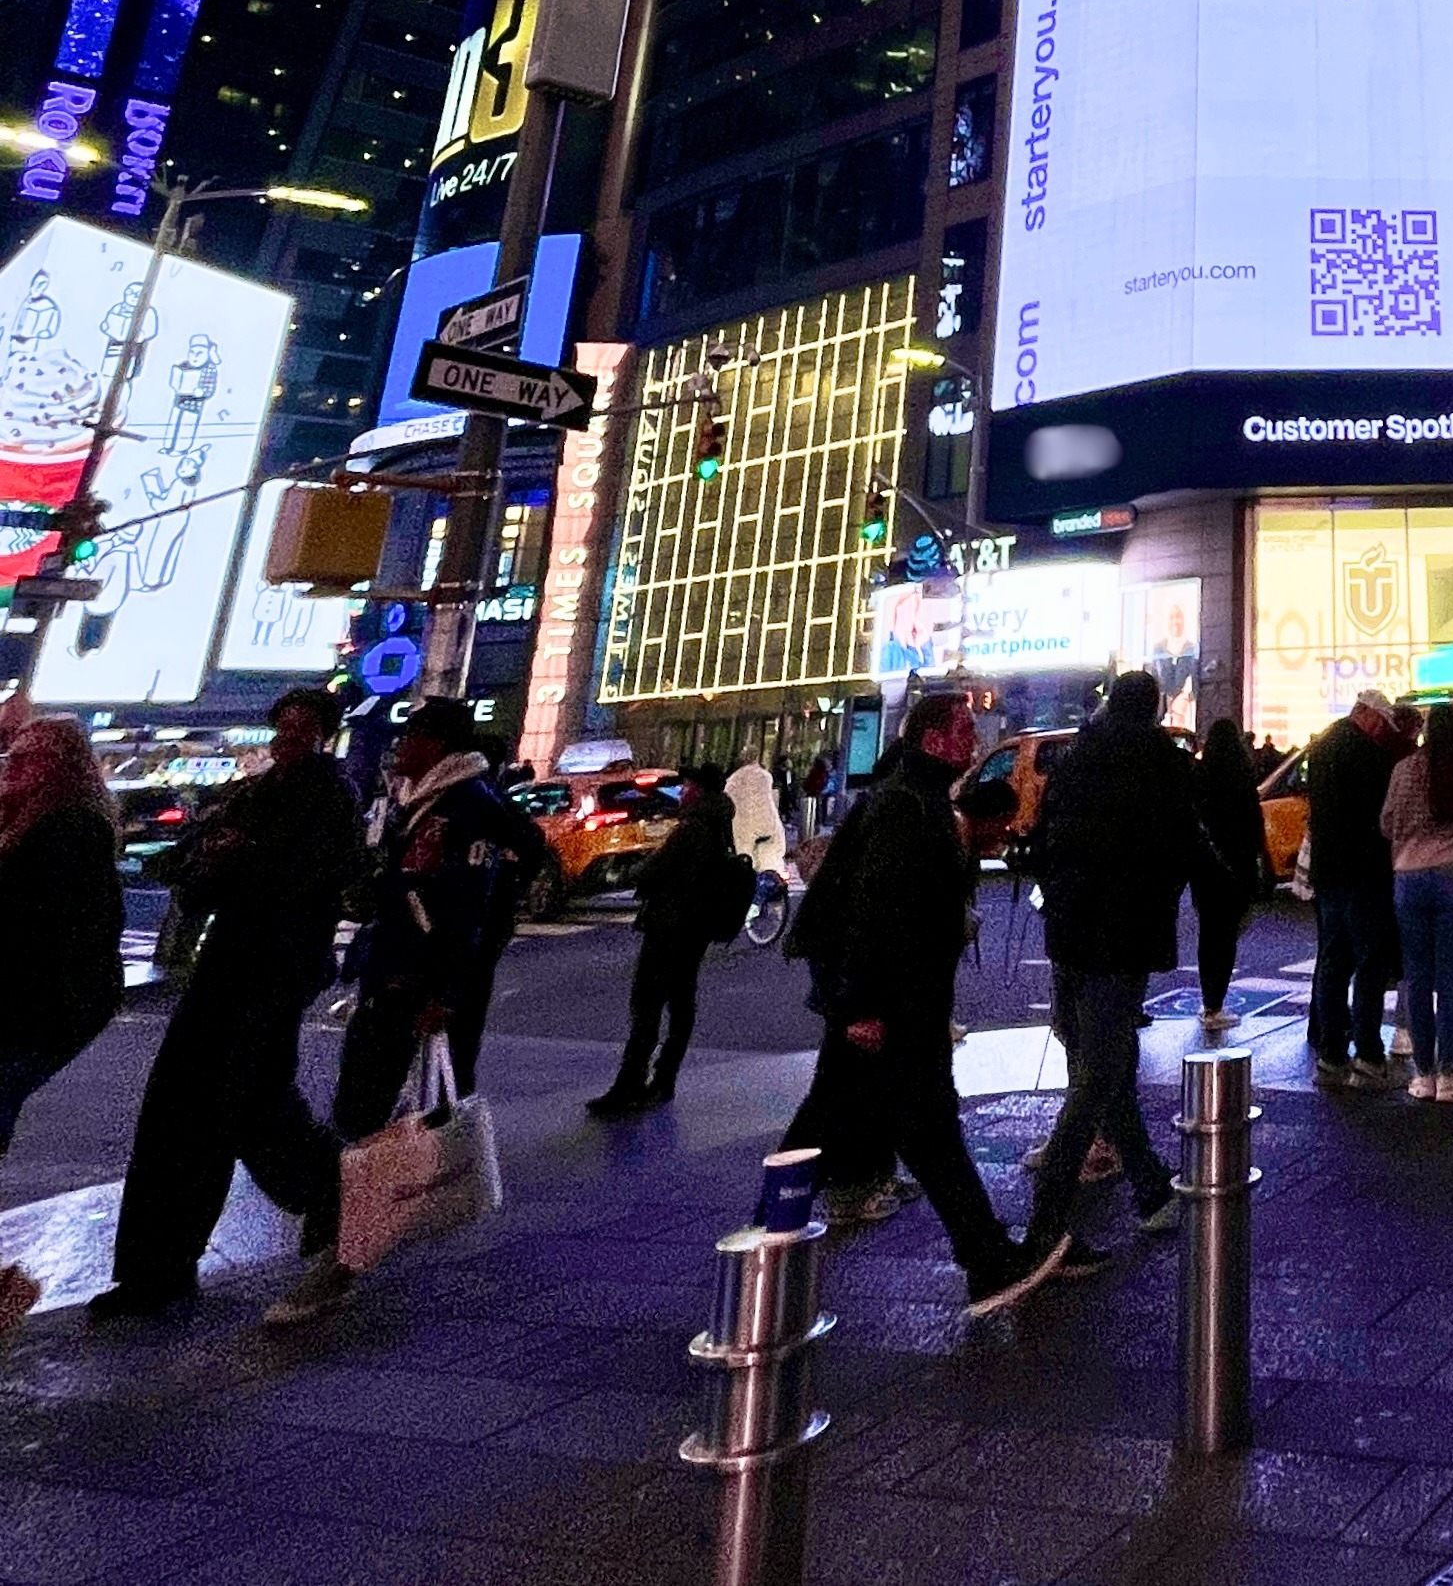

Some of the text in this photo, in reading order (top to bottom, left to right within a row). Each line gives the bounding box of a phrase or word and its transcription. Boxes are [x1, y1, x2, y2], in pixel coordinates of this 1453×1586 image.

[430, 152, 518, 208] Live 24/7
[1124, 261, 1257, 296] starteryou.com
[450, 300, 513, 344] ONE WAY
[443, 364, 569, 409] ONE WAY
[404, 418, 448, 439] CHASE
[1243, 413, 1380, 444] Customer
[1053, 510, 1101, 535] branded
[543, 545, 587, 662] TIMES
[965, 606, 1030, 632] very
[963, 633, 1071, 657] martphone
[1315, 653, 1411, 679] TOUR
[536, 683, 566, 704] 3
